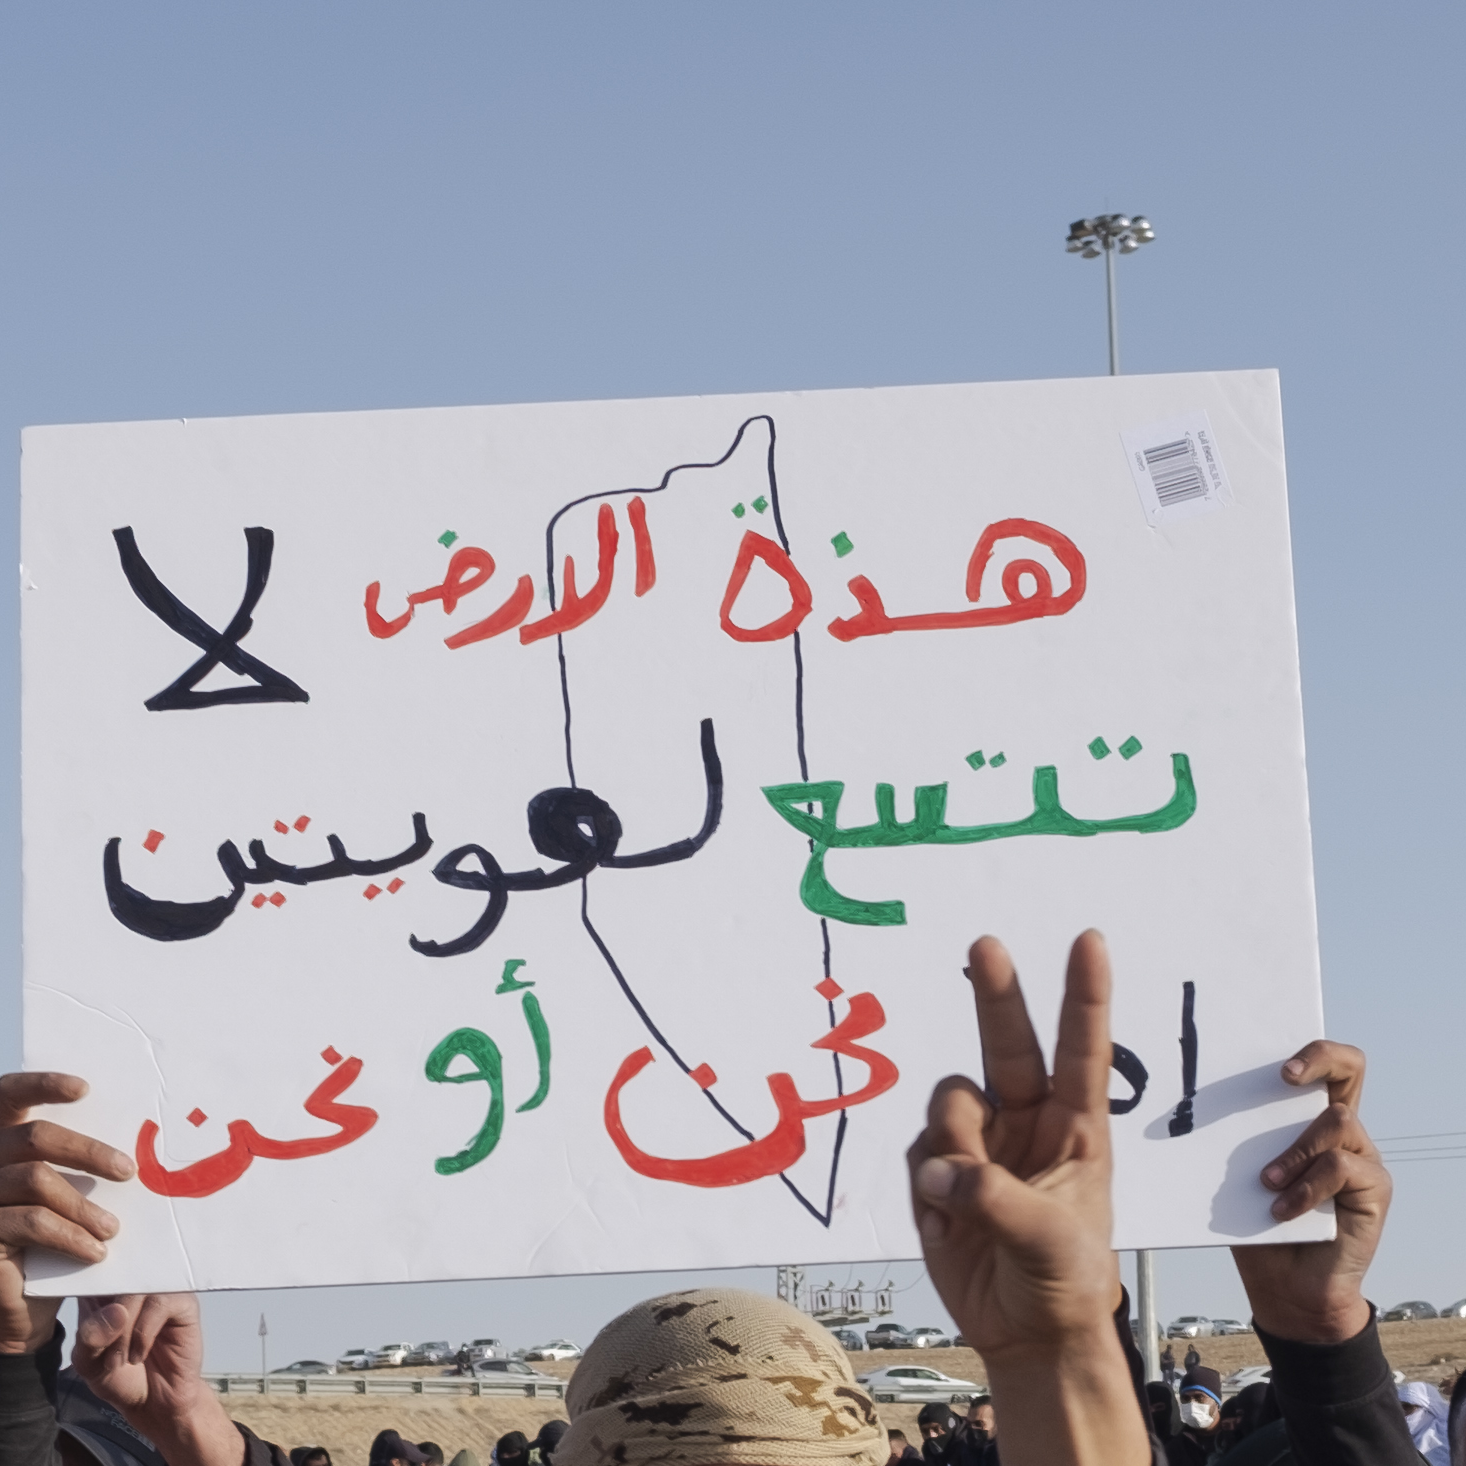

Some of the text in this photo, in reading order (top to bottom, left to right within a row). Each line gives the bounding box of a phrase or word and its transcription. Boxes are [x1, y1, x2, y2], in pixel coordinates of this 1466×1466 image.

[113, 526, 310, 711] لا
[761, 735, 1197, 926] تتسع
[135, 1045, 379, 1199] نحن
[425, 959, 551, 1176] أو
[604, 976, 899, 1189] نحن
